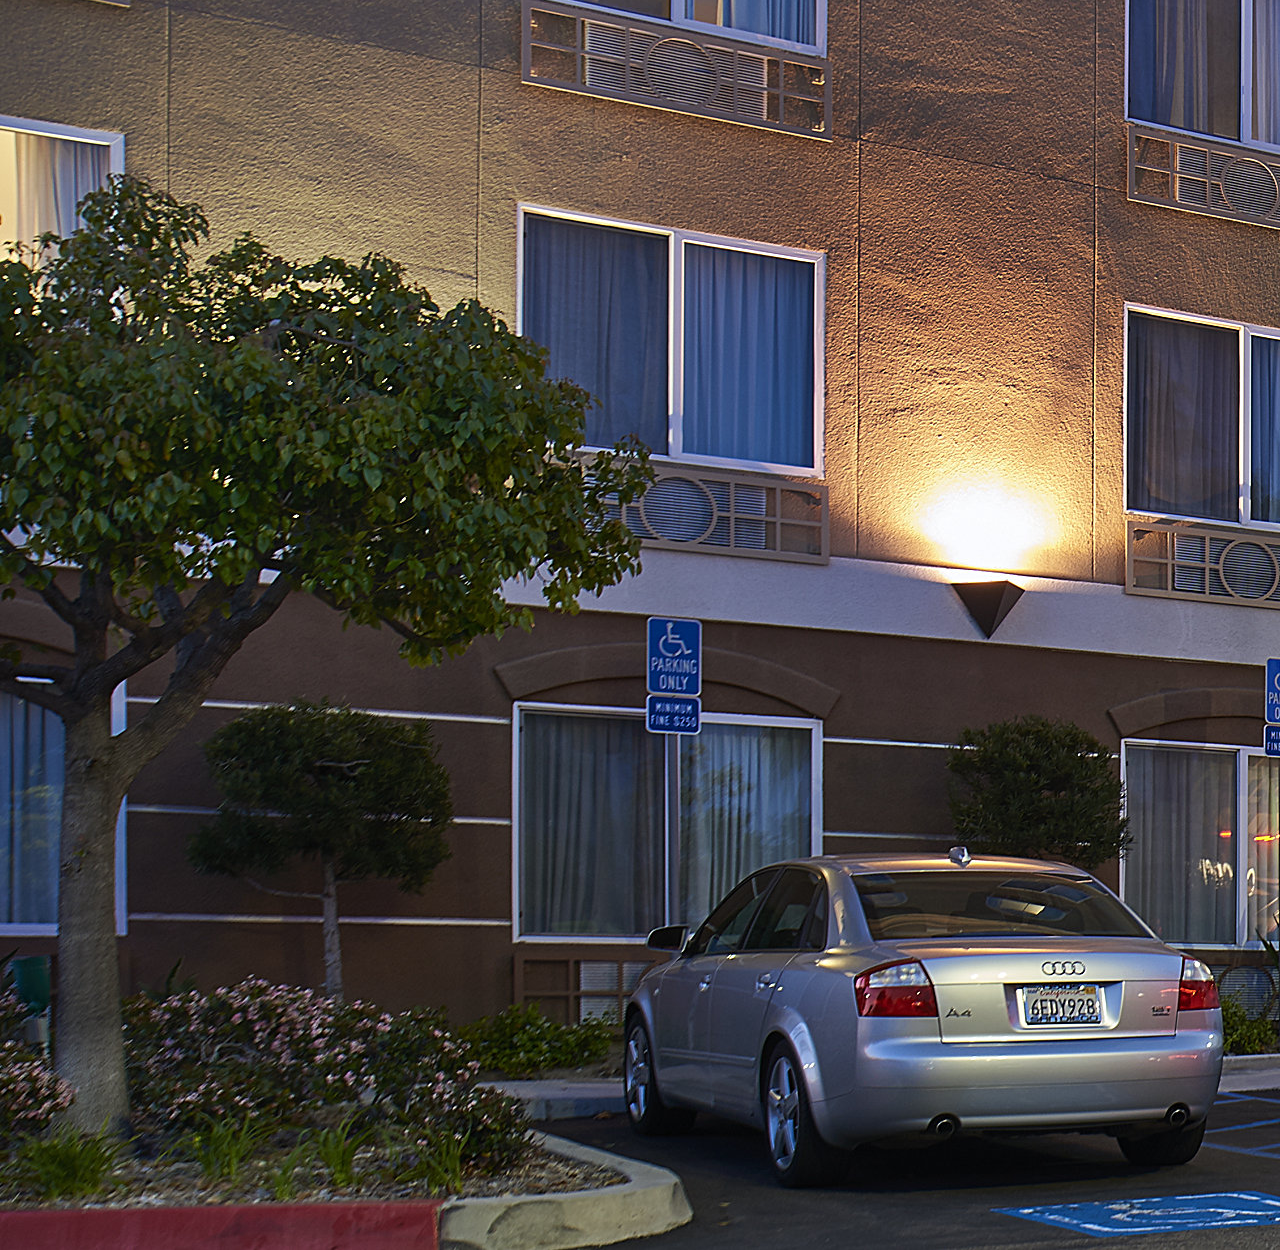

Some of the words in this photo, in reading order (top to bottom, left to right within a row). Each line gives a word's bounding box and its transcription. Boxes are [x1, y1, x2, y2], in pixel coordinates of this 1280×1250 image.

[651, 657, 697, 674] PARKING
[659, 674, 688, 690] ONLY
[655, 702, 692, 714] MINIMUM
[650, 715, 670, 726] FINE
[673, 716, 697, 728] $250
[945, 1006, 971, 1018] A4
[1031, 998, 1096, 1016] 6EDY928
